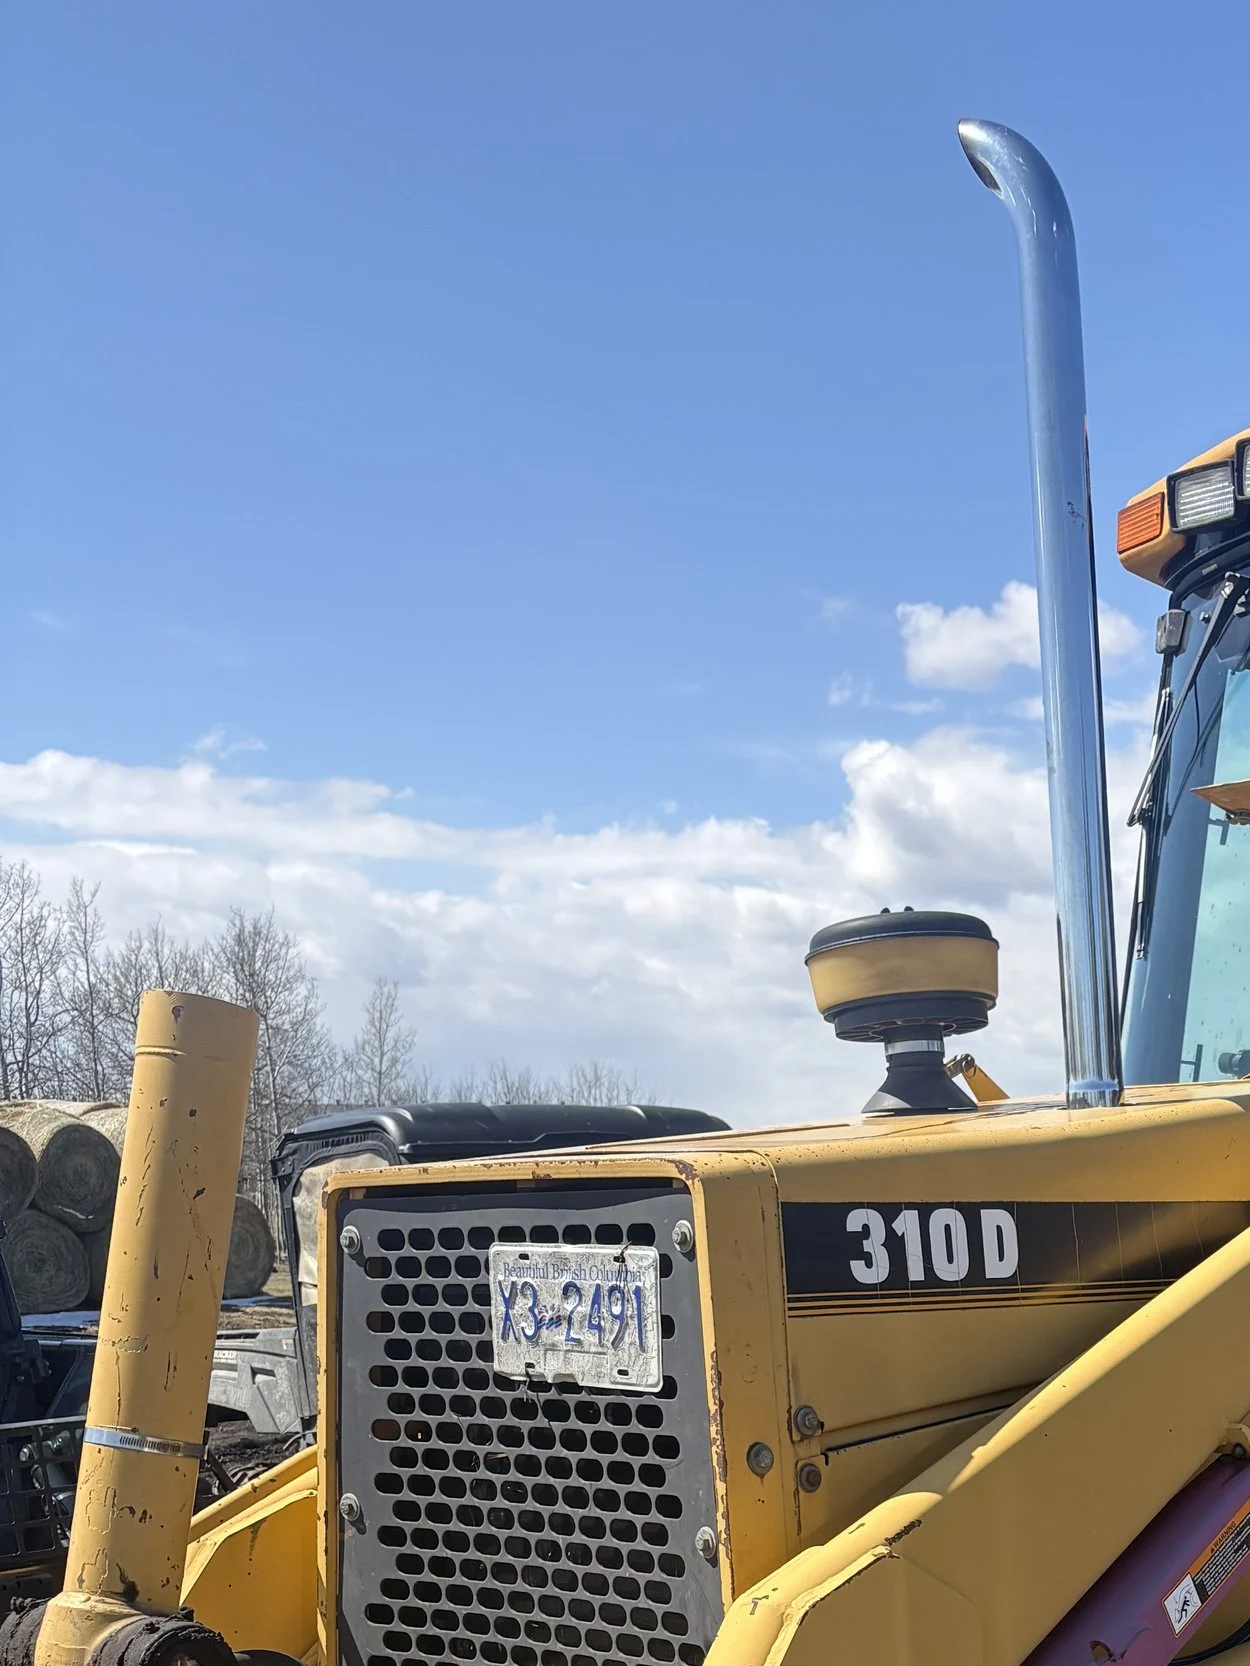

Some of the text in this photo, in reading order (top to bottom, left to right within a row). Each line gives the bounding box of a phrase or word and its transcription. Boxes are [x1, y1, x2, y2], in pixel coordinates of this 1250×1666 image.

[503, 1262, 642, 1283] Beautiful British Columbia
[498, 1281, 646, 1353] X3 2491
[1213, 1520, 1237, 1547] WARNING
